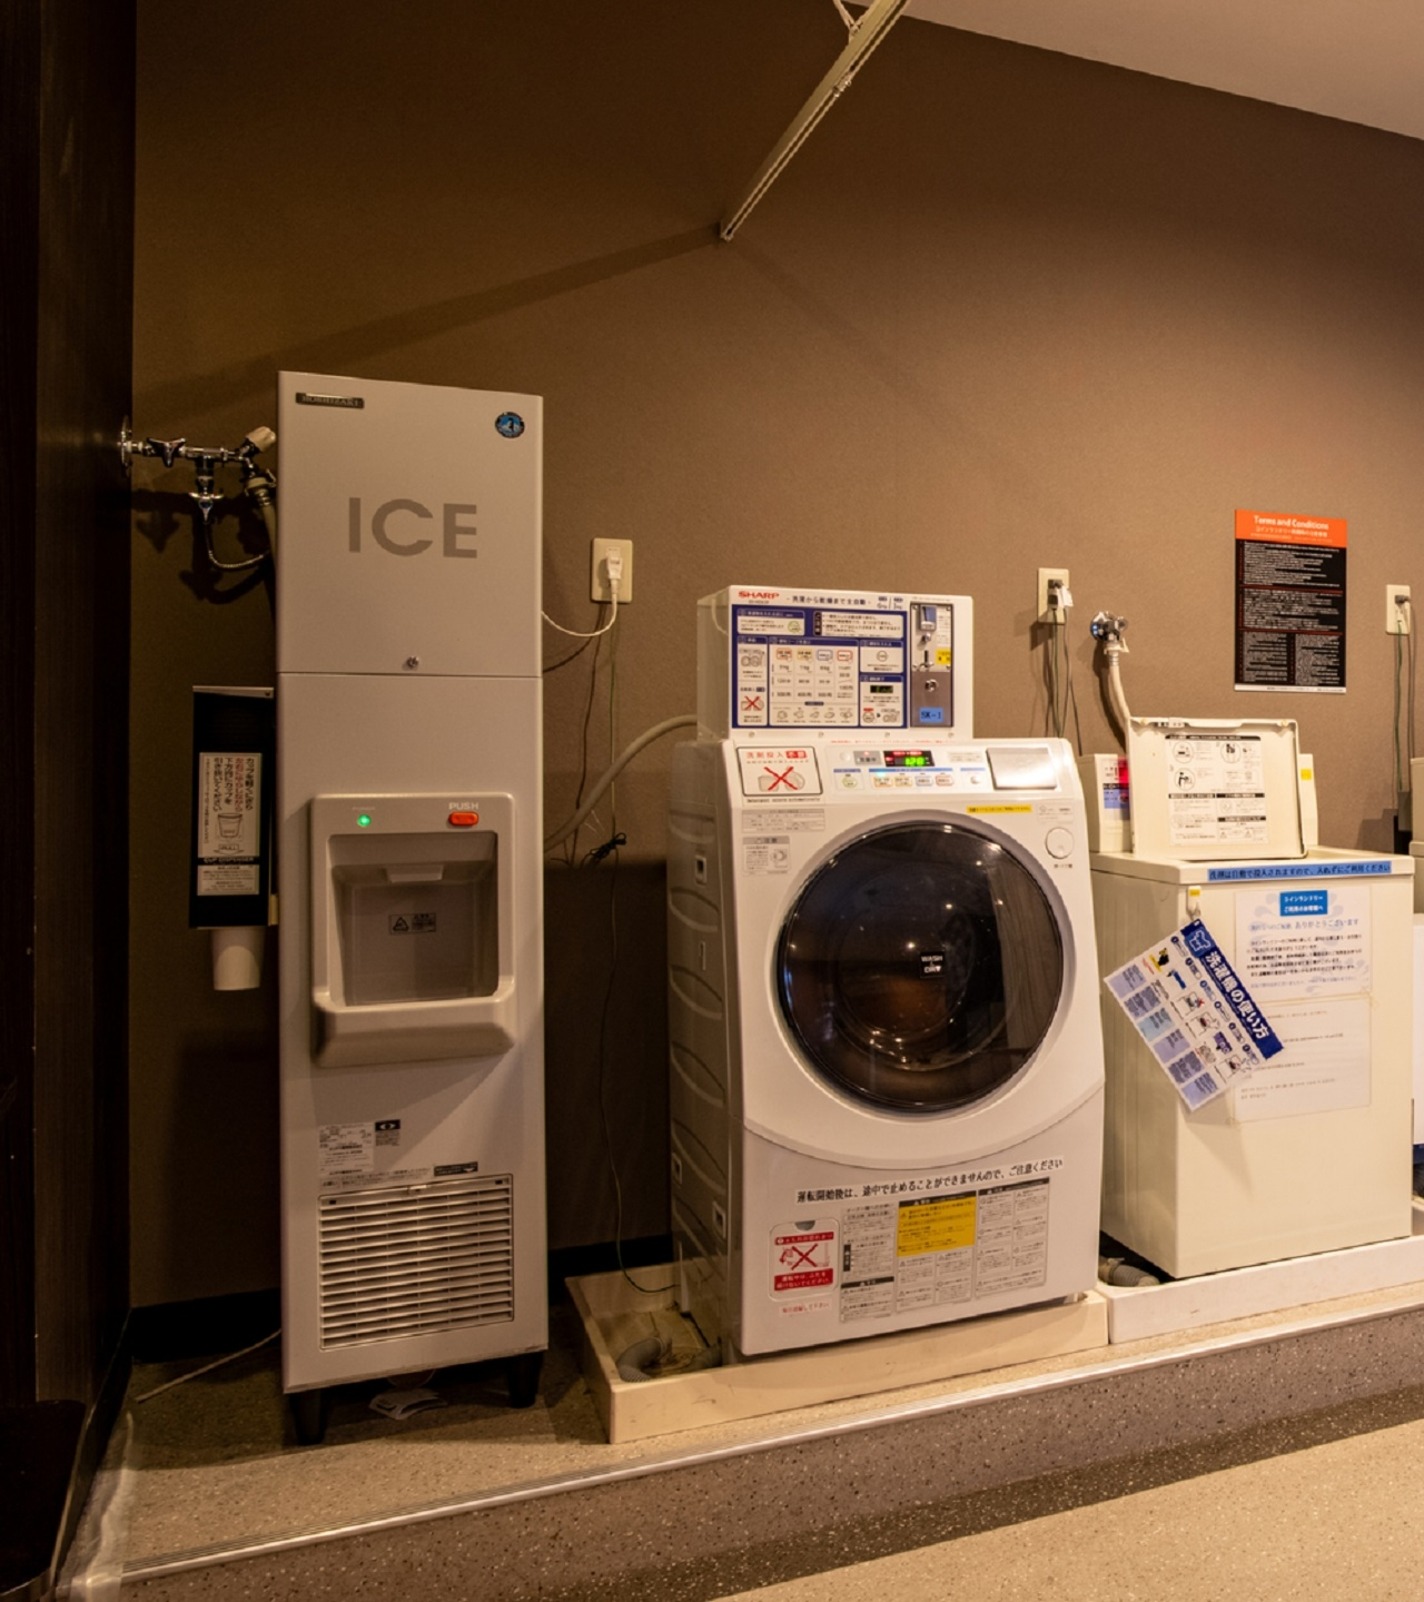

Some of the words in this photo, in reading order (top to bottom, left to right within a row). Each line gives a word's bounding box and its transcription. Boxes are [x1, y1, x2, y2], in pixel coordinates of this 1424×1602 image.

[348, 497, 478, 559] ICE
[1253, 515, 1277, 526] Terms
[1277, 519, 1291, 527] and
[1291, 519, 1329, 530] Conditions
[738, 590, 780, 601] SHARP
[448, 801, 480, 811] PUSH
[1204, 950, 1270, 1039] 洗濯機の使い方
[797, 1158, 1063, 1202] 運転開始後は、途中で止めることができませんので、ご注意ください
